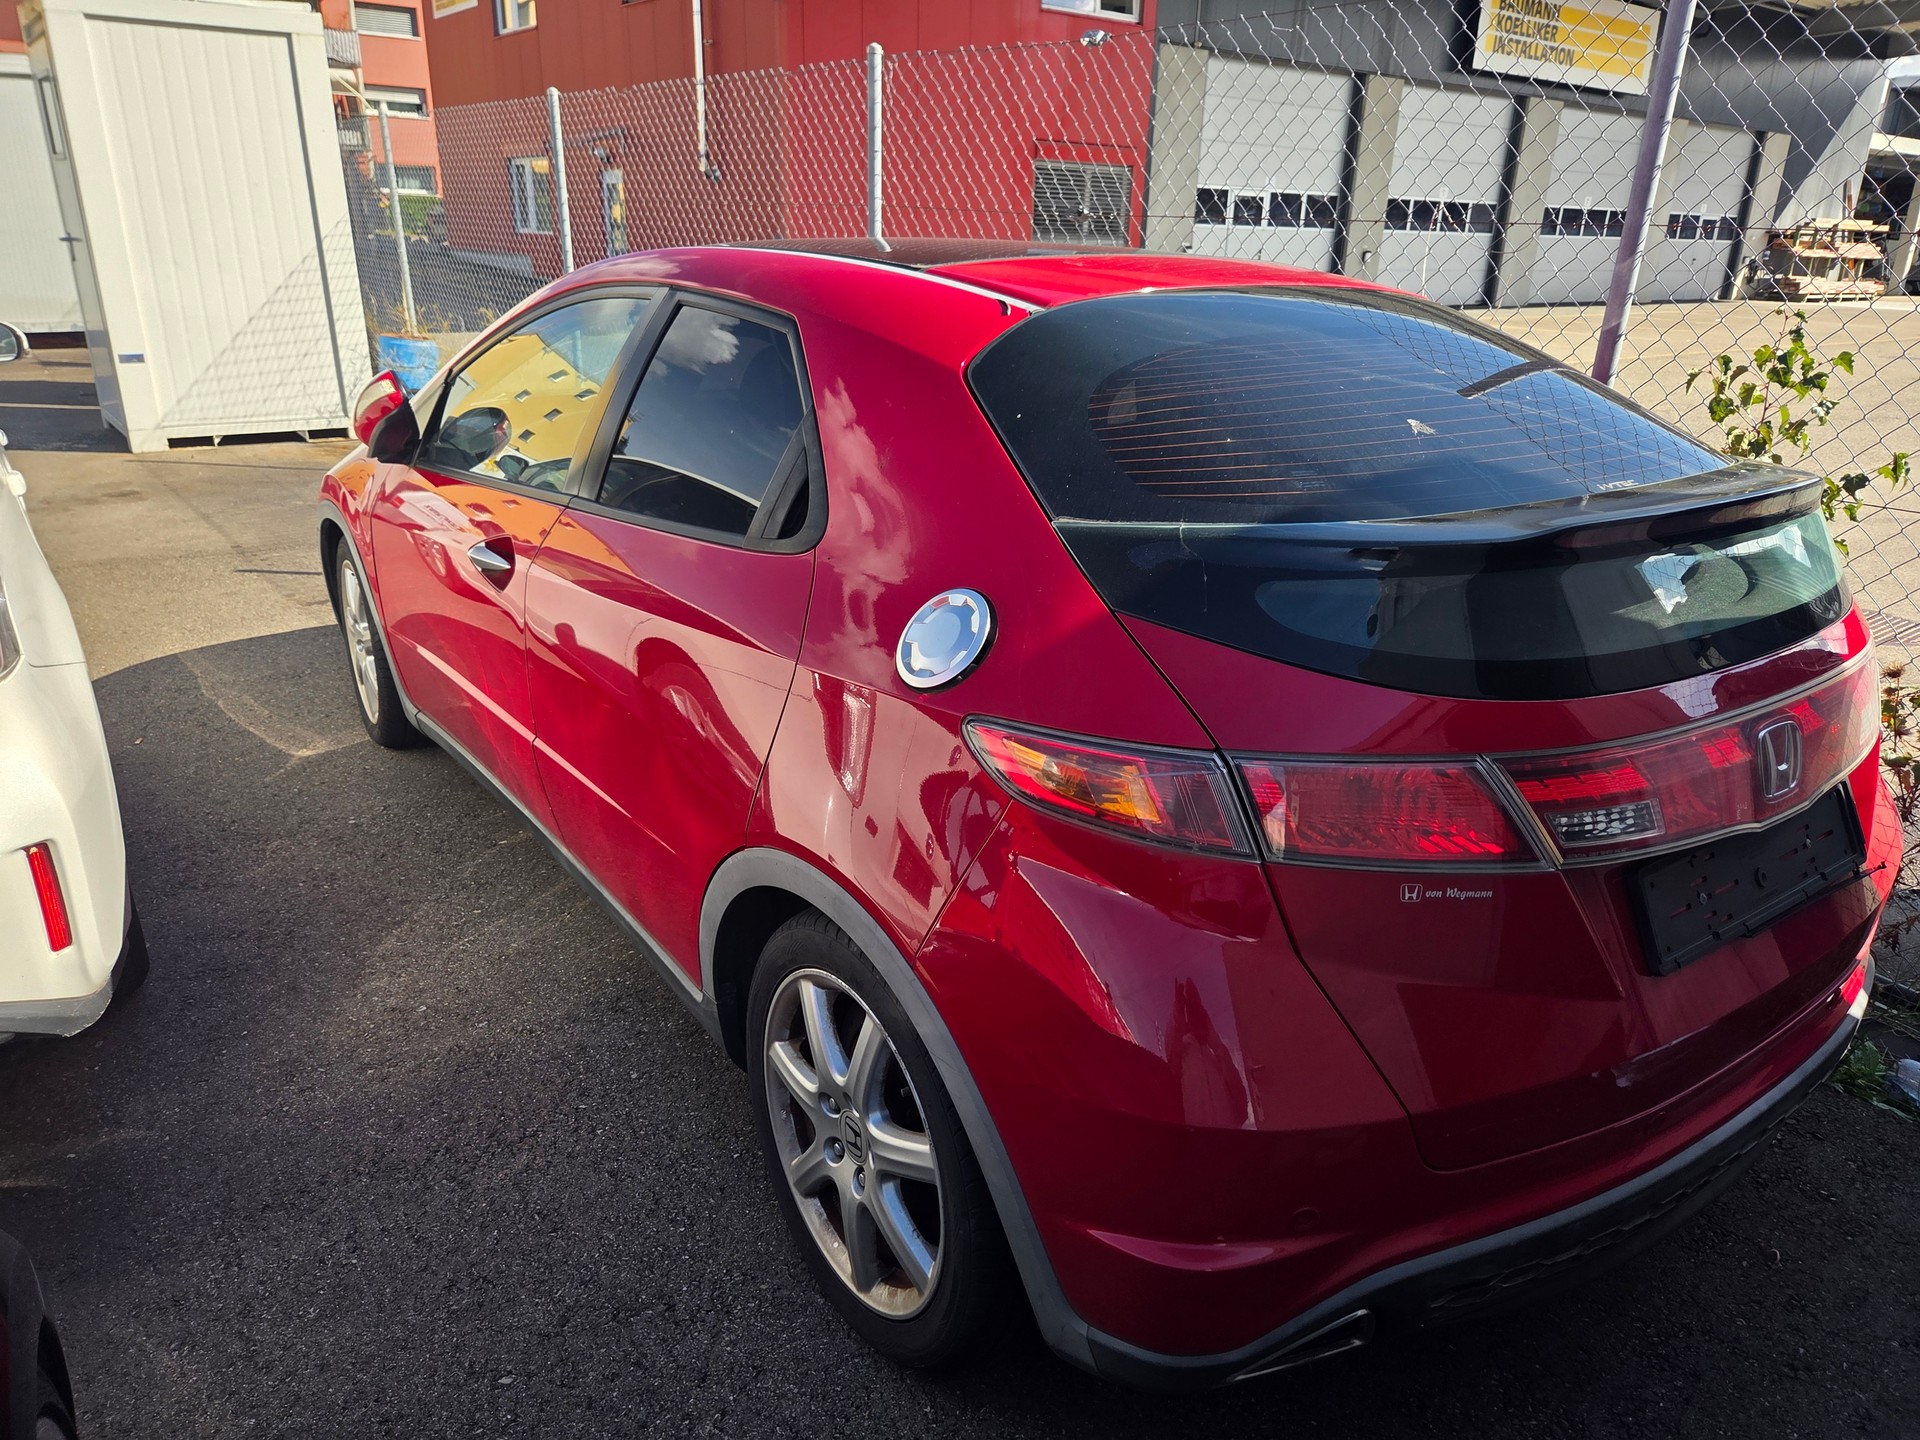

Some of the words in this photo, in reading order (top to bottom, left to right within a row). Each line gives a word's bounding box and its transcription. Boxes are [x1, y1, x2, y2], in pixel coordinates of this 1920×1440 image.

[1499, 0, 1560, 22] BAUMANN
[1495, 13, 1559, 43] KOELLIKER
[1492, 35, 1575, 66] INSTALLATION
[1425, 890, 1443, 898] von
[1446, 887, 1493, 900] Wegmann
